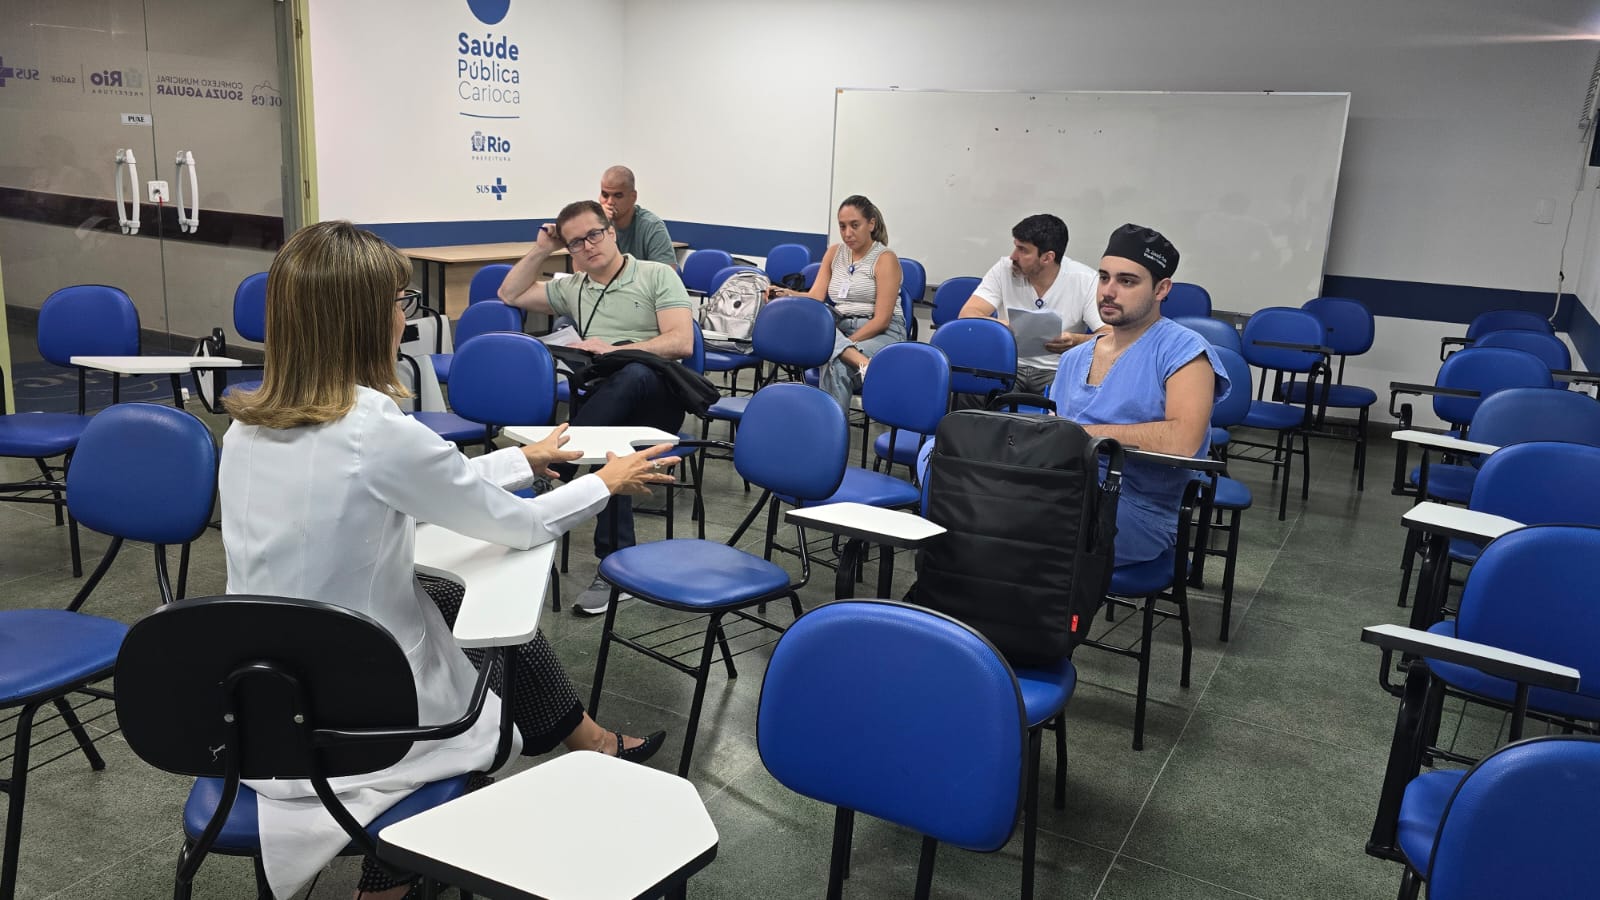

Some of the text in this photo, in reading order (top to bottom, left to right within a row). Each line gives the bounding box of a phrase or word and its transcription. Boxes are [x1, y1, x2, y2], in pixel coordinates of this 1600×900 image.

[458, 32, 519, 61] Saúde
[458, 59, 520, 84] Pública
[458, 80, 520, 104] Carioca
[487, 136, 511, 153] Rio
[476, 185, 490, 194] SUS
